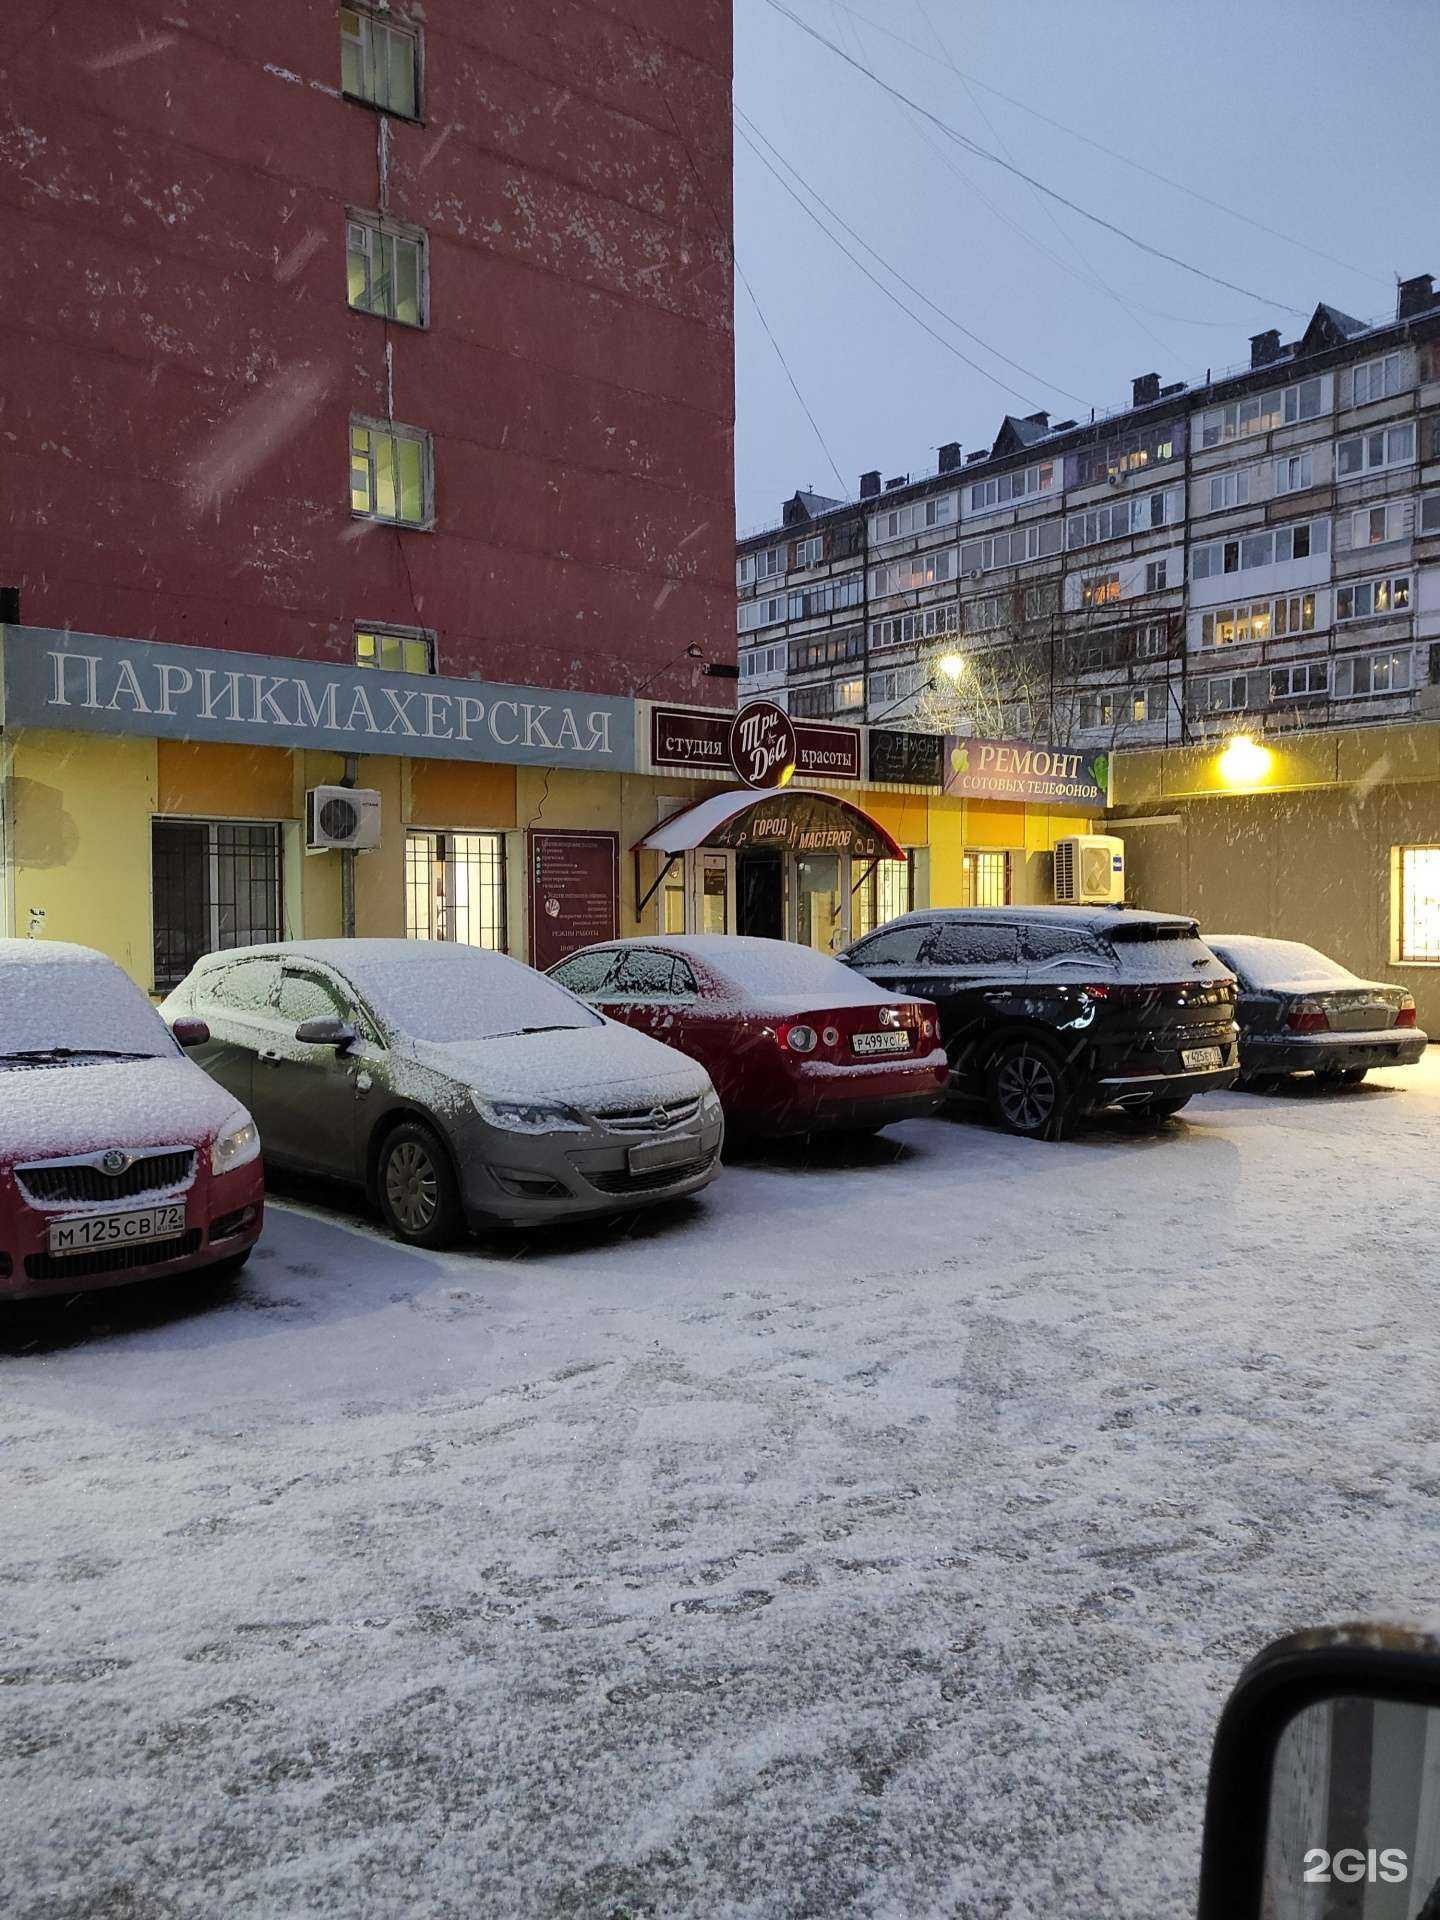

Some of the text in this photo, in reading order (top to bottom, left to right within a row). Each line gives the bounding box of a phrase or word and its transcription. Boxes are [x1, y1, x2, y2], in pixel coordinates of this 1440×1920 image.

[47, 652, 613, 753] ПАРИКМАХЕРСКАЯ
[665, 736, 723, 758] студия
[739, 711, 779, 753] Три
[749, 734, 788, 782] Два
[801, 748, 852, 769] красоты
[977, 746, 1083, 778] РЕМОНТ
[963, 775, 1098, 798] СОТОВЫХ ТЕЛЕФОНОВ
[752, 818, 852, 849] ГОРОД МАСТЕРОВ
